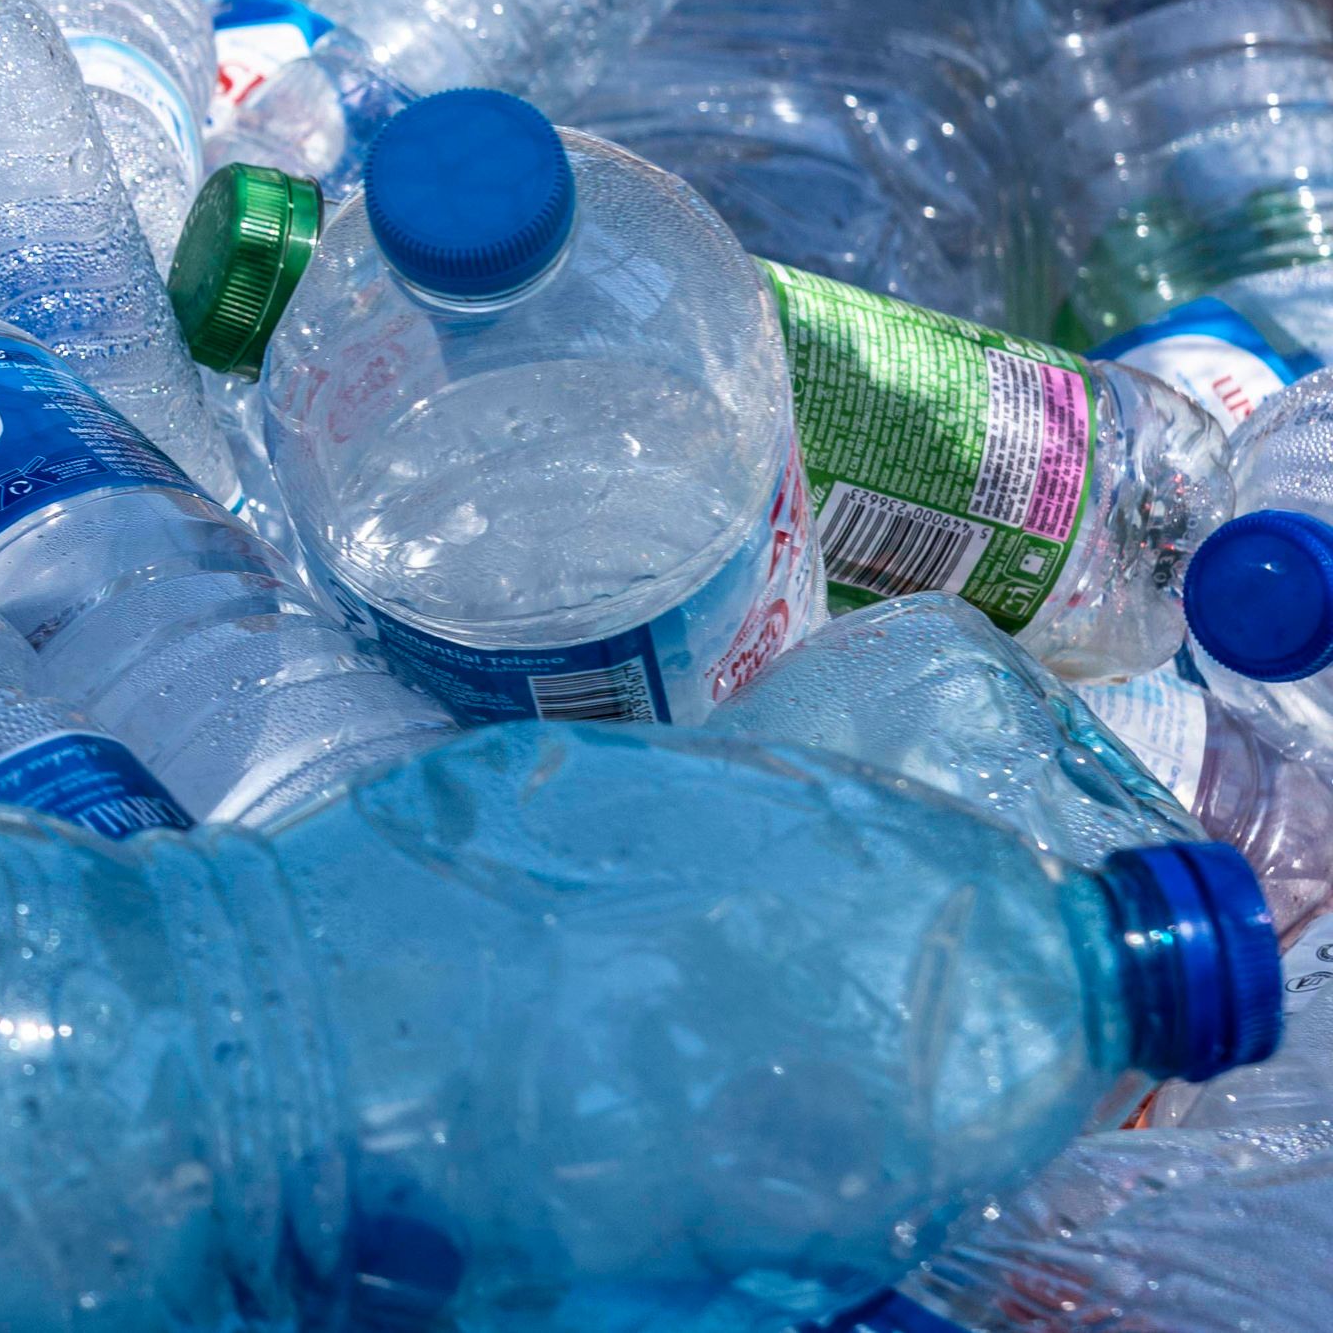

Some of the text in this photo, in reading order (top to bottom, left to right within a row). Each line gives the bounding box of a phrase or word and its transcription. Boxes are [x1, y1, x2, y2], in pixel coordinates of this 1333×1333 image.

[1212, 372, 1254, 425] LUS
[847, 486, 907, 517] 236623
[910, 506, 971, 534] 449000
[979, 525, 991, 541] 5
[487, 655, 565, 666] Teleno
